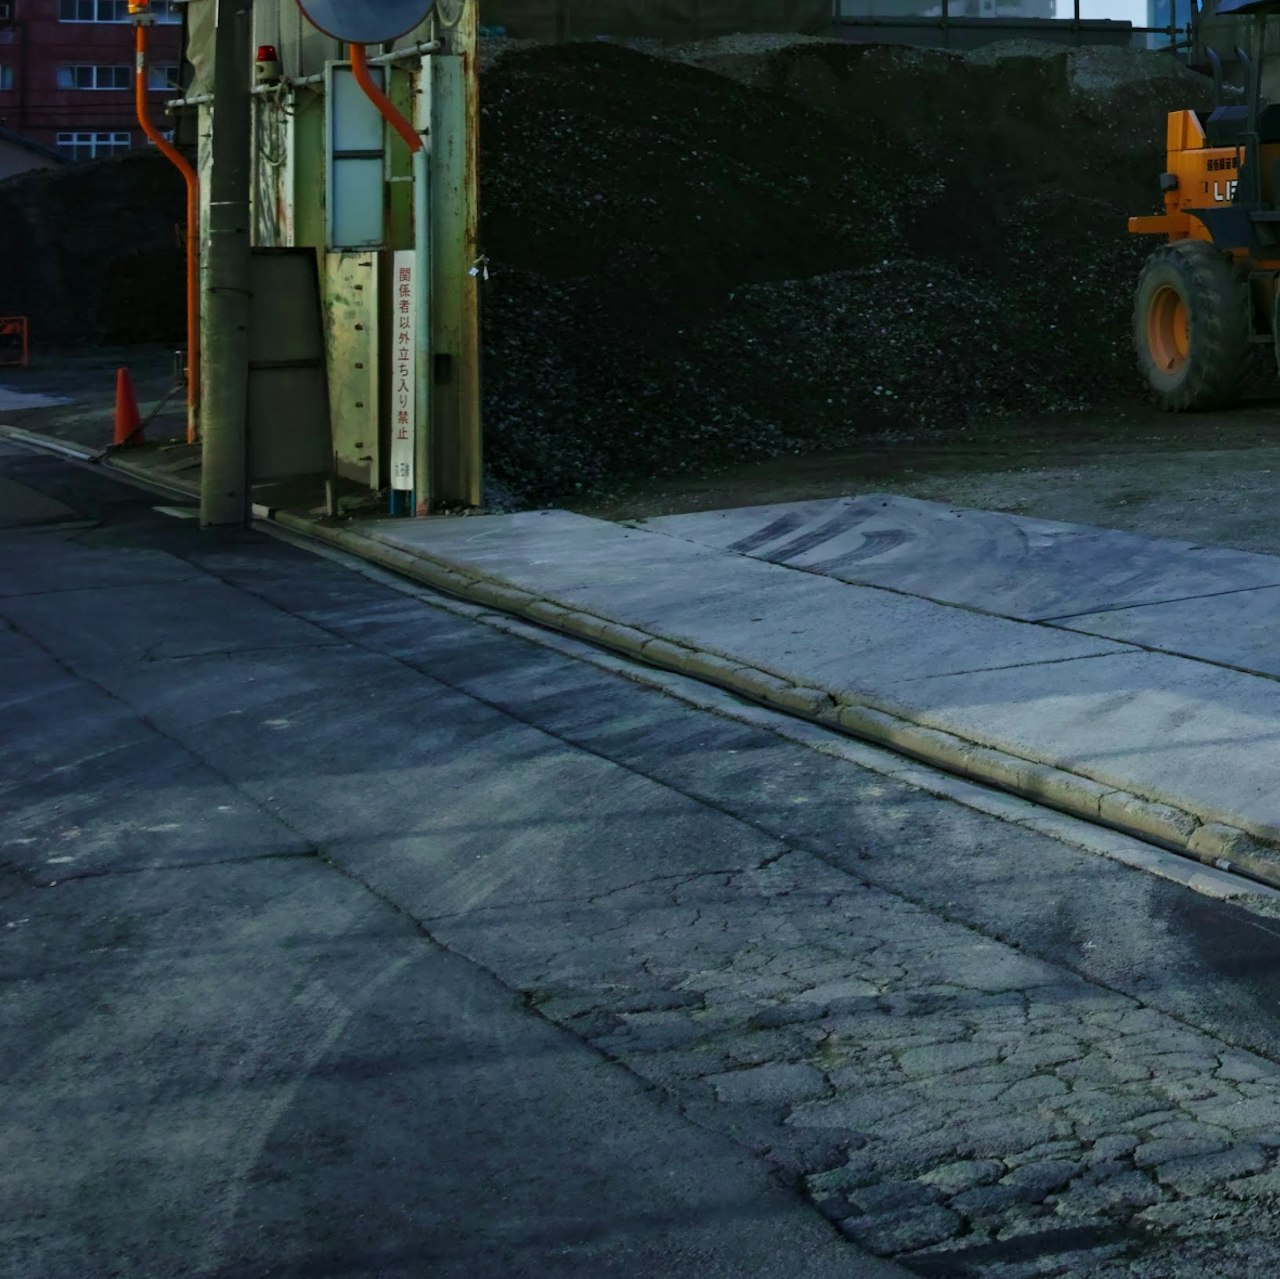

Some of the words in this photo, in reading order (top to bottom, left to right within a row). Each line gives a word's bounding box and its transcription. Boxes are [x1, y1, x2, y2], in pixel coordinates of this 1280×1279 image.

[396, 267, 411, 440] 関係者以外立ち入り禁止
